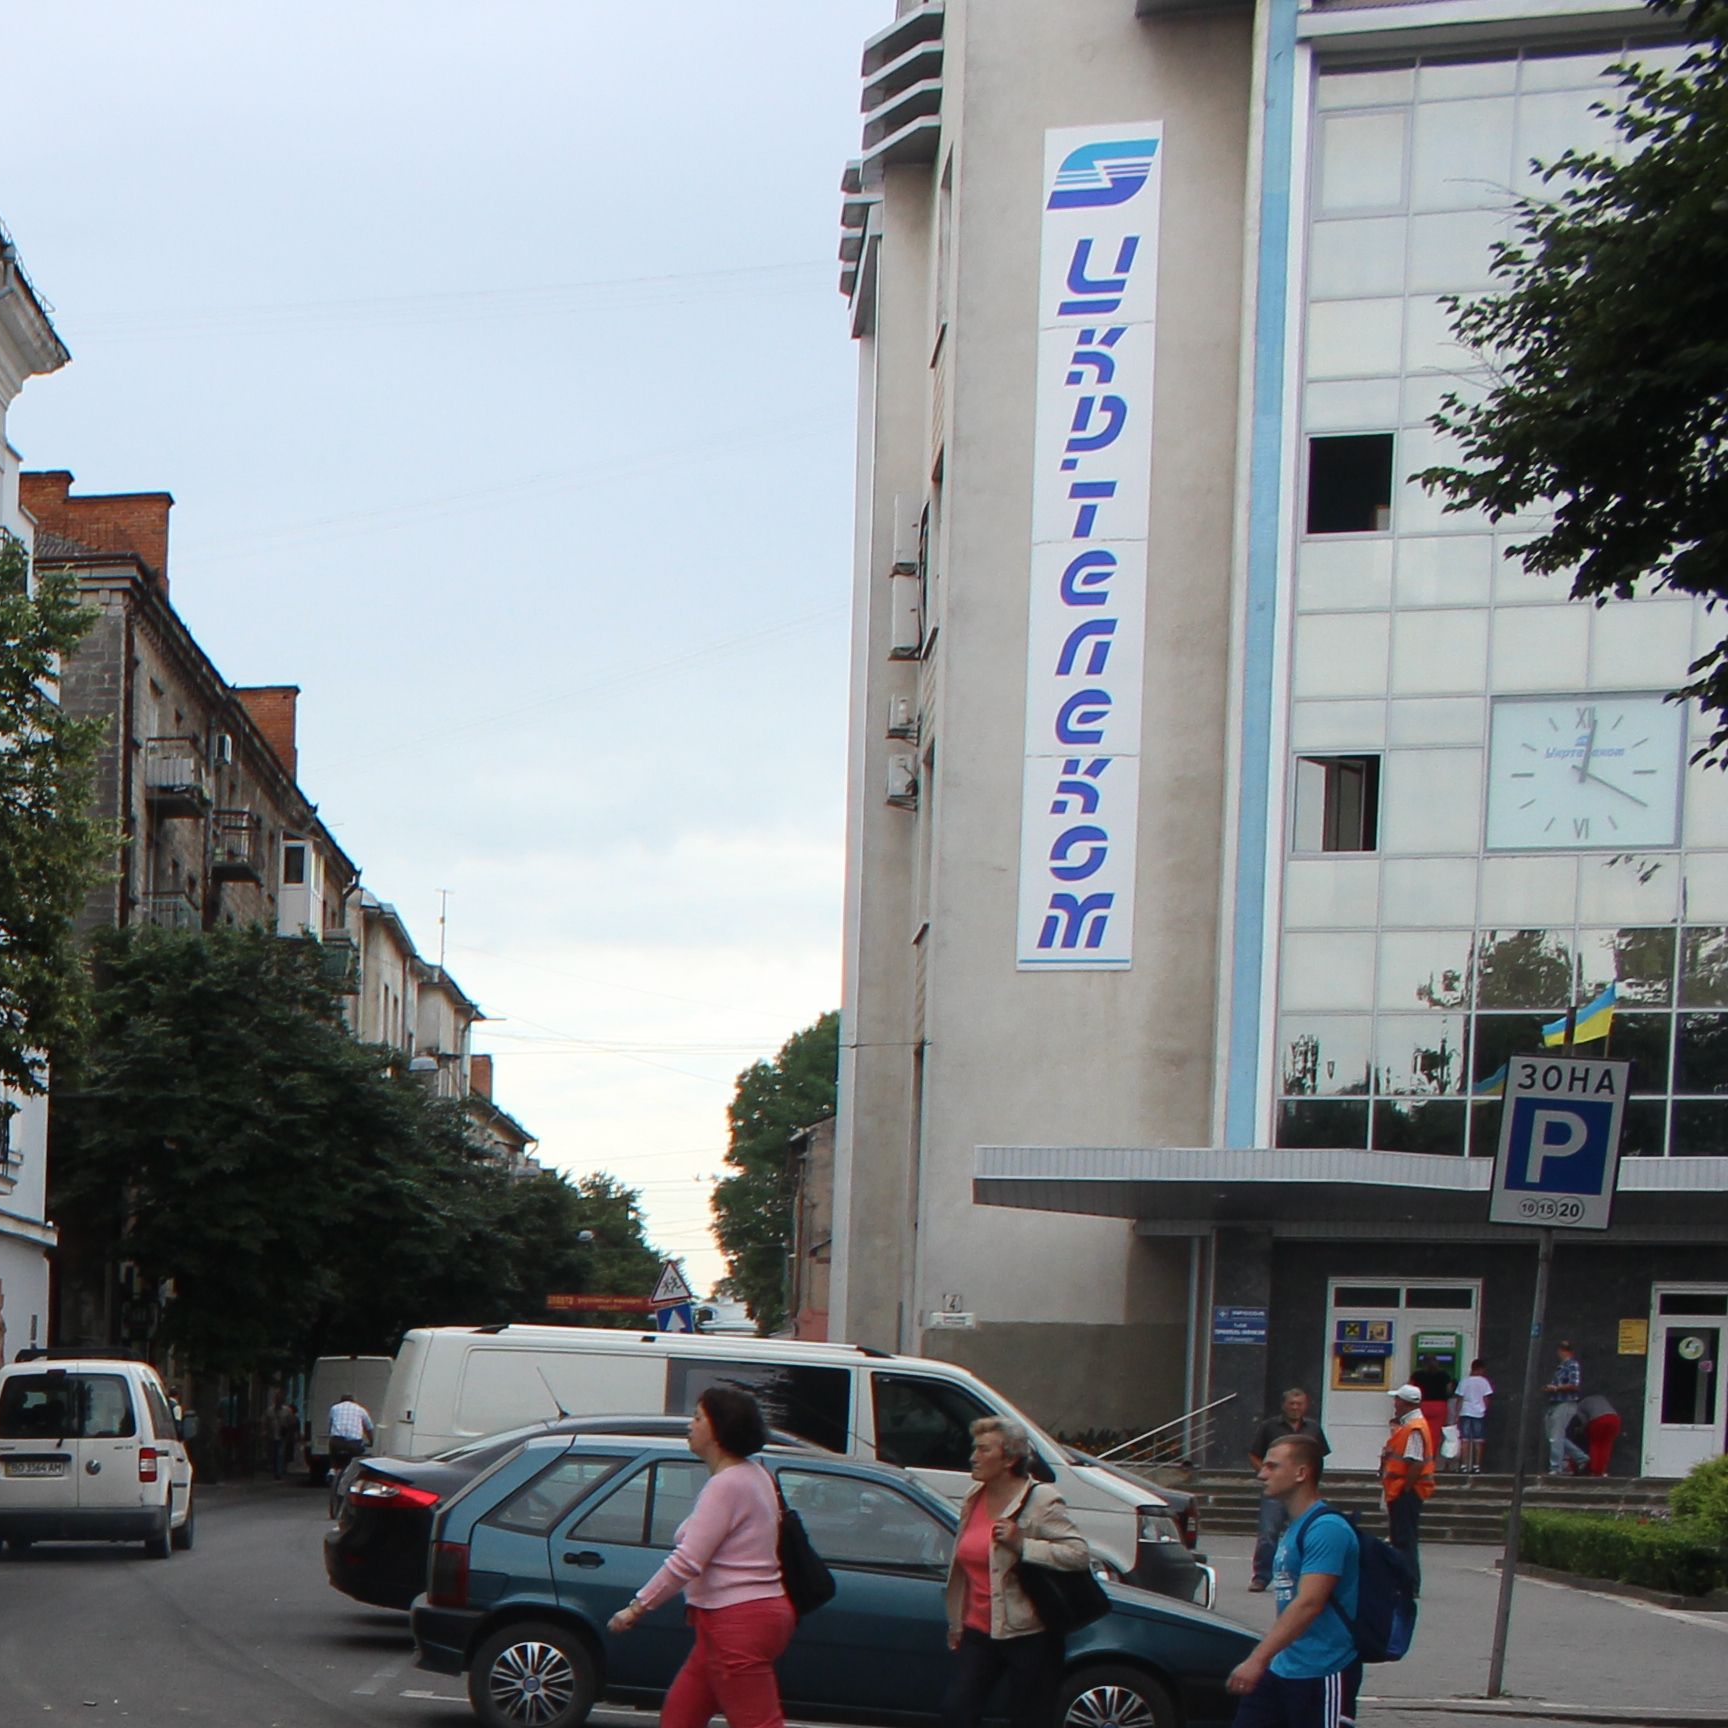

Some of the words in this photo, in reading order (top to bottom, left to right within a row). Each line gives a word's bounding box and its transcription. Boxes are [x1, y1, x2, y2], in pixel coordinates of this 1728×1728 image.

[1544, 747, 1626, 761] Укртееком
[1573, 817, 1590, 840] VI
[1517, 1063, 1616, 1095] ЗОНА
[1538, 1203, 1554, 1215] 15
[1559, 1203, 1580, 1218] 20
